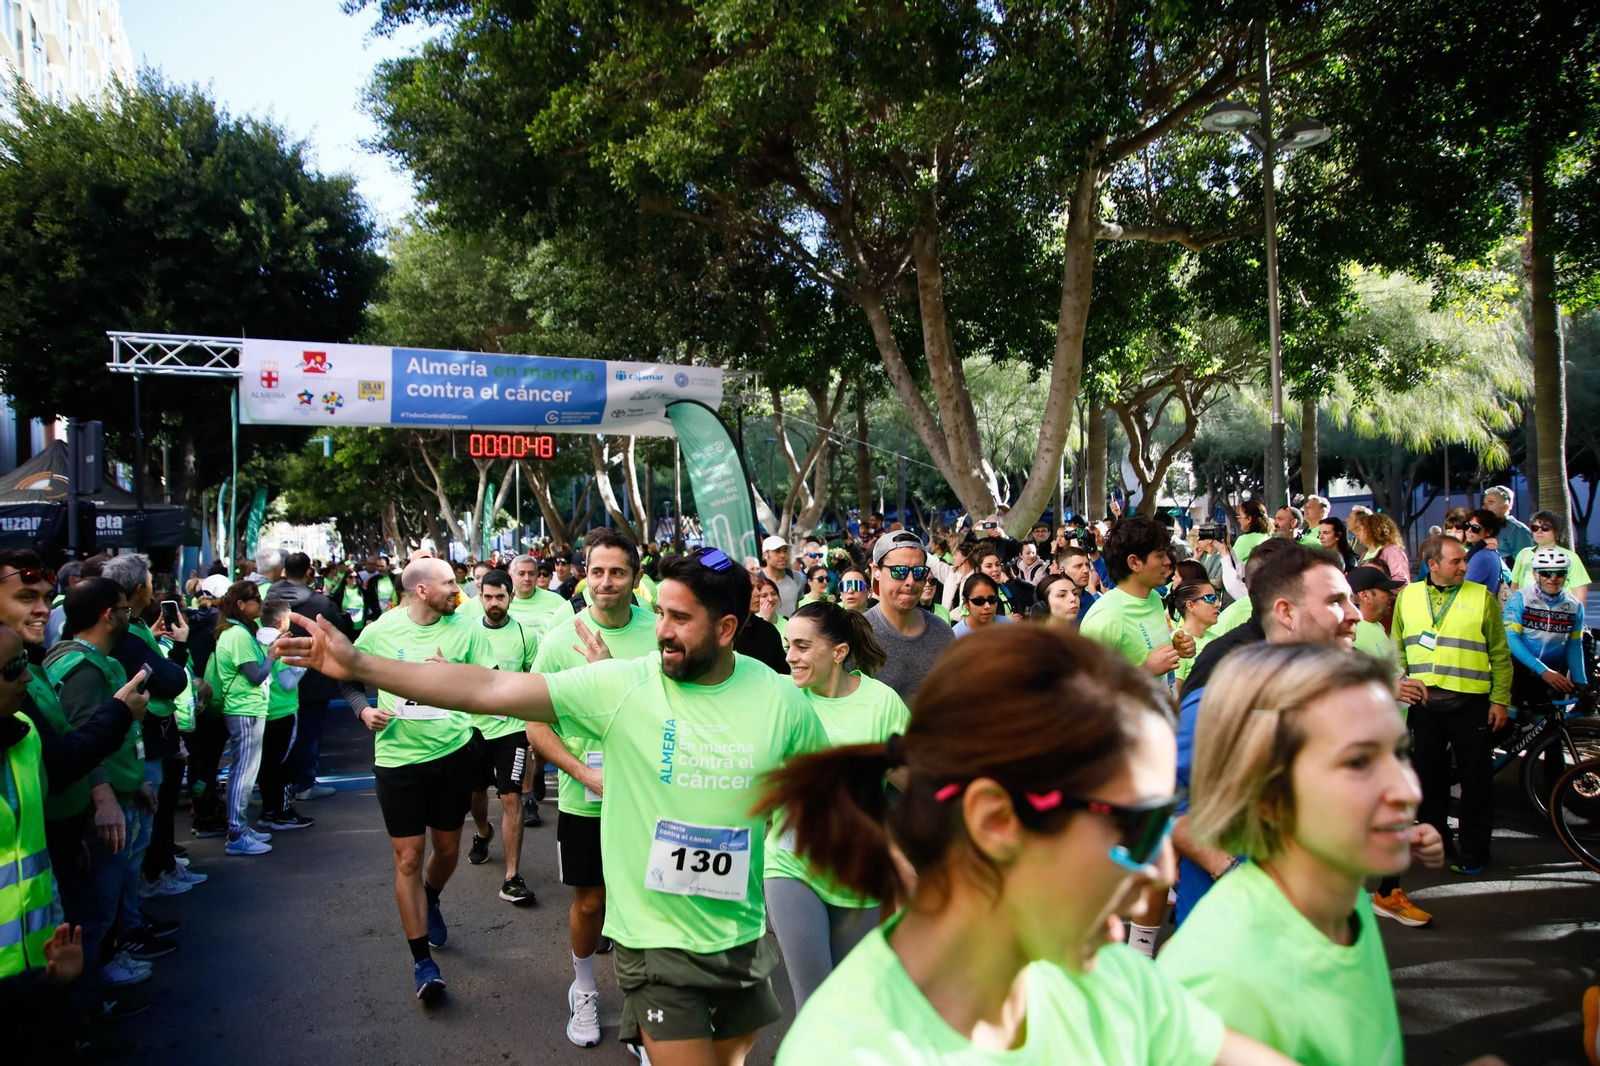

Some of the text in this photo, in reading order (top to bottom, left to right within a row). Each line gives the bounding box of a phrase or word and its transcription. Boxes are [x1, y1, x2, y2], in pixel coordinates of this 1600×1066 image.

[406, 357, 596, 383] Almería en marcha
[250, 391, 286, 399] ALMERÍA
[406, 381, 573, 403] contra el cáncer
[470, 434, 553, 458] 00:00:48
[660, 719, 677, 784] ALMERÍA
[678, 737, 754, 754] En marcha
[678, 755, 754, 769] contra el
[676, 769, 755, 790] cáncer
[659, 829, 681, 840] contra
[688, 835, 713, 845] cáncer
[670, 847, 733, 877] 130
